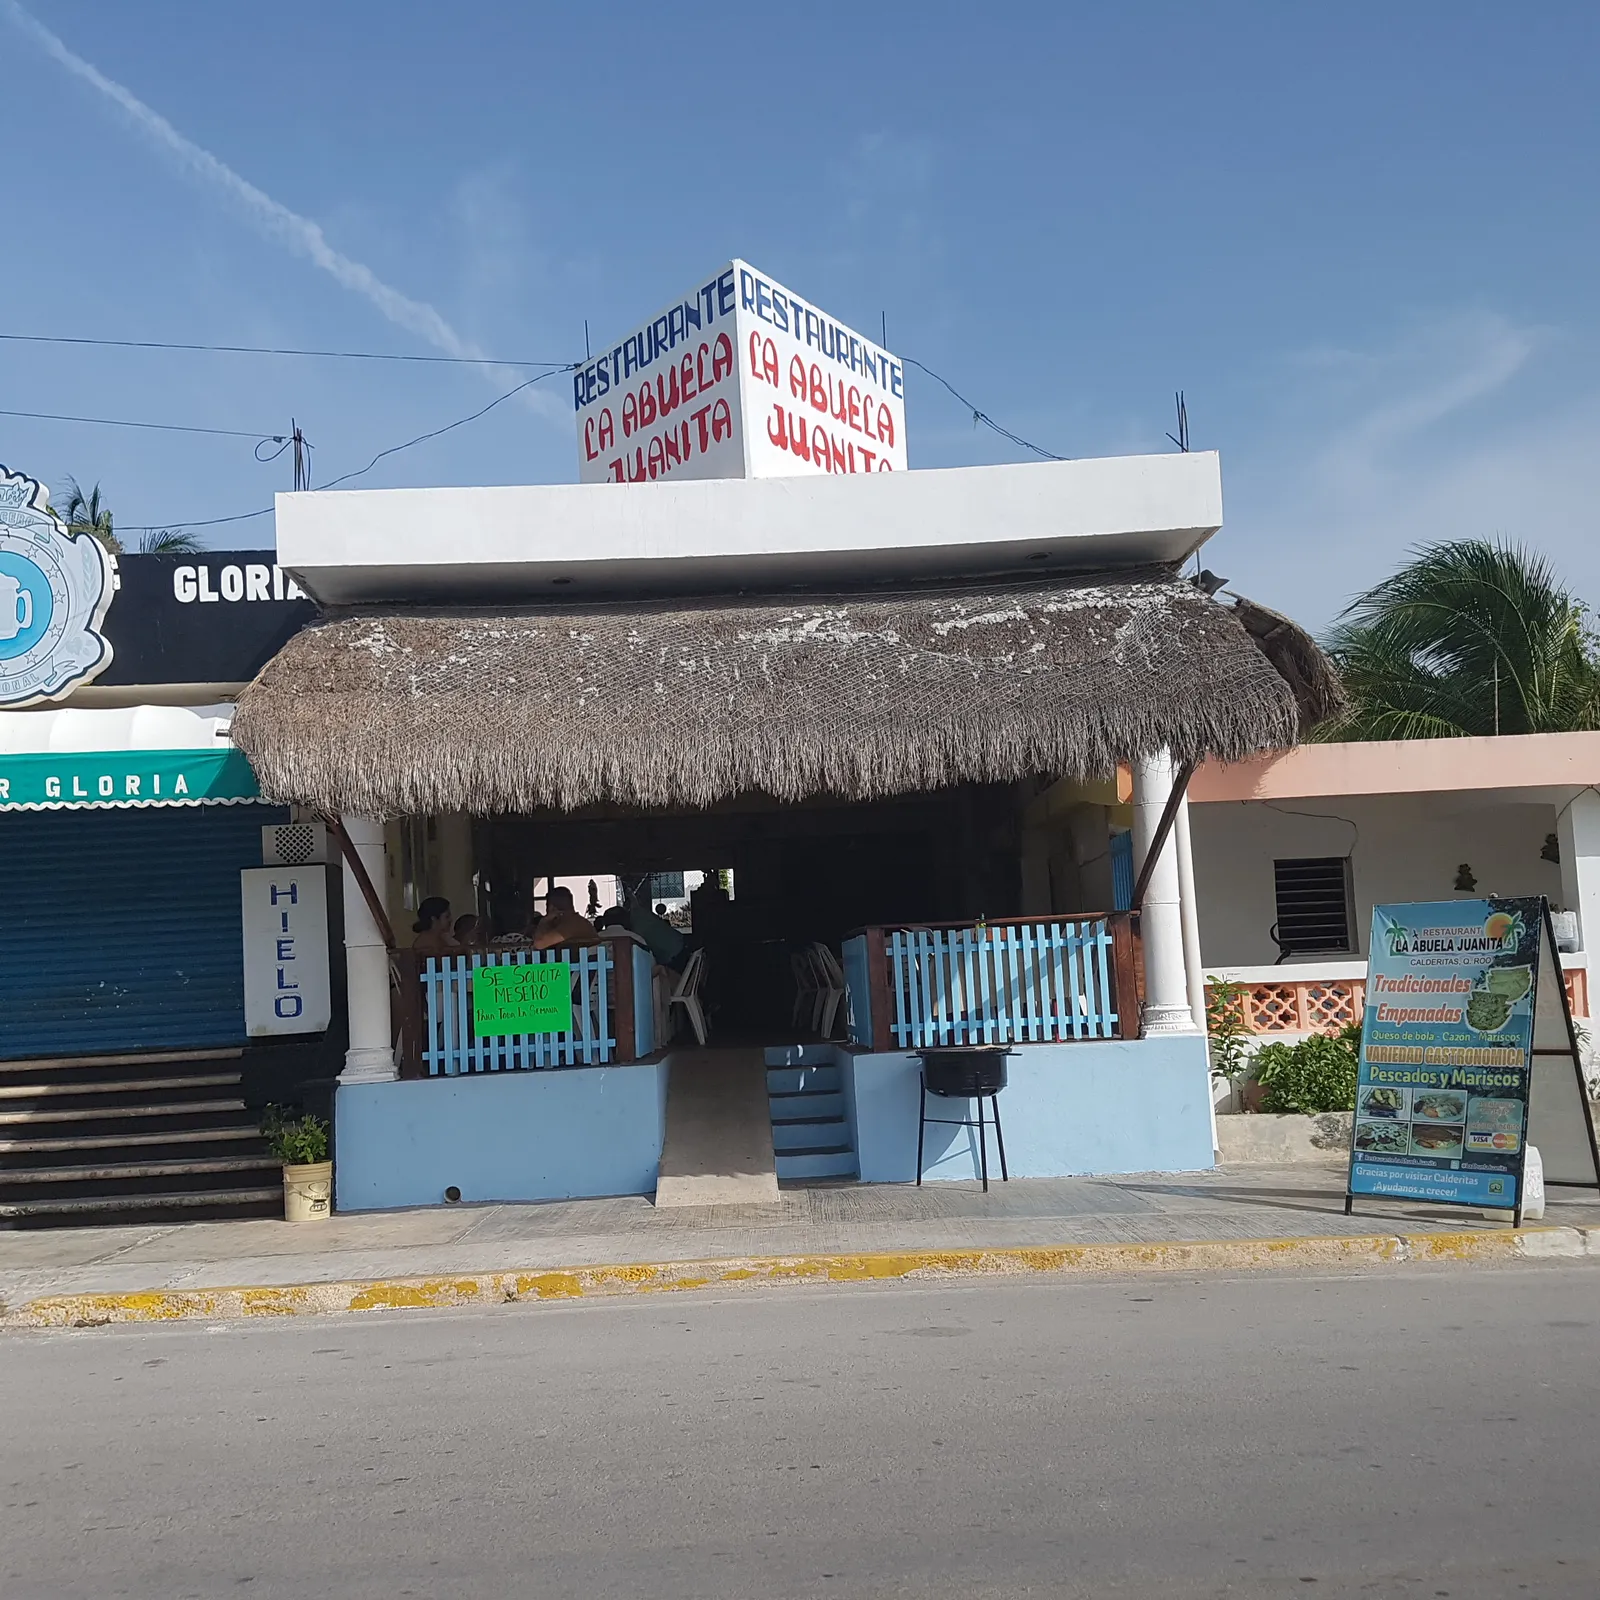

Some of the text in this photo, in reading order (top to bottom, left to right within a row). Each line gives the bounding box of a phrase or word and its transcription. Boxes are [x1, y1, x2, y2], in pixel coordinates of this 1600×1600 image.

[574, 269, 735, 411] RESTAURANTE
[740, 268, 903, 399] RESTAURANTE
[584, 332, 733, 461] LA ABUELA
[749, 331, 894, 449] LA ABUELA
[607, 398, 732, 483] JUANITA
[46, 774, 189, 797] GLORIA
[1423, 927, 1481, 936] RESTAURANT
[269, 879, 303, 1018] HIELO
[1395, 937, 1503, 953] LA ABUELA JUANITA
[1410, 957, 1461, 966] CALDERITAS,
[1474, 956, 1492, 965] ROO
[481, 966, 561, 987] SE SOLICITA
[1374, 974, 1471, 994] Tradicionales
[494, 984, 548, 1003] MESERO
[1376, 1003, 1462, 1026] Empanadas
[1371, 1030, 1400, 1040] Queso
[1402, 1031, 1413, 1040] de
[1415, 1031, 1435, 1041] bola
[1479, 1031, 1521, 1042] Mariscos
[1365, 1045, 1424, 1063] VARIEDAD
[1370, 1066, 1521, 1088] Pescados y Mariscos
[1356, 1166, 1479, 1185] Gracias por visitar Calderitas
[1426, 1187, 1458, 1197] crecer!
